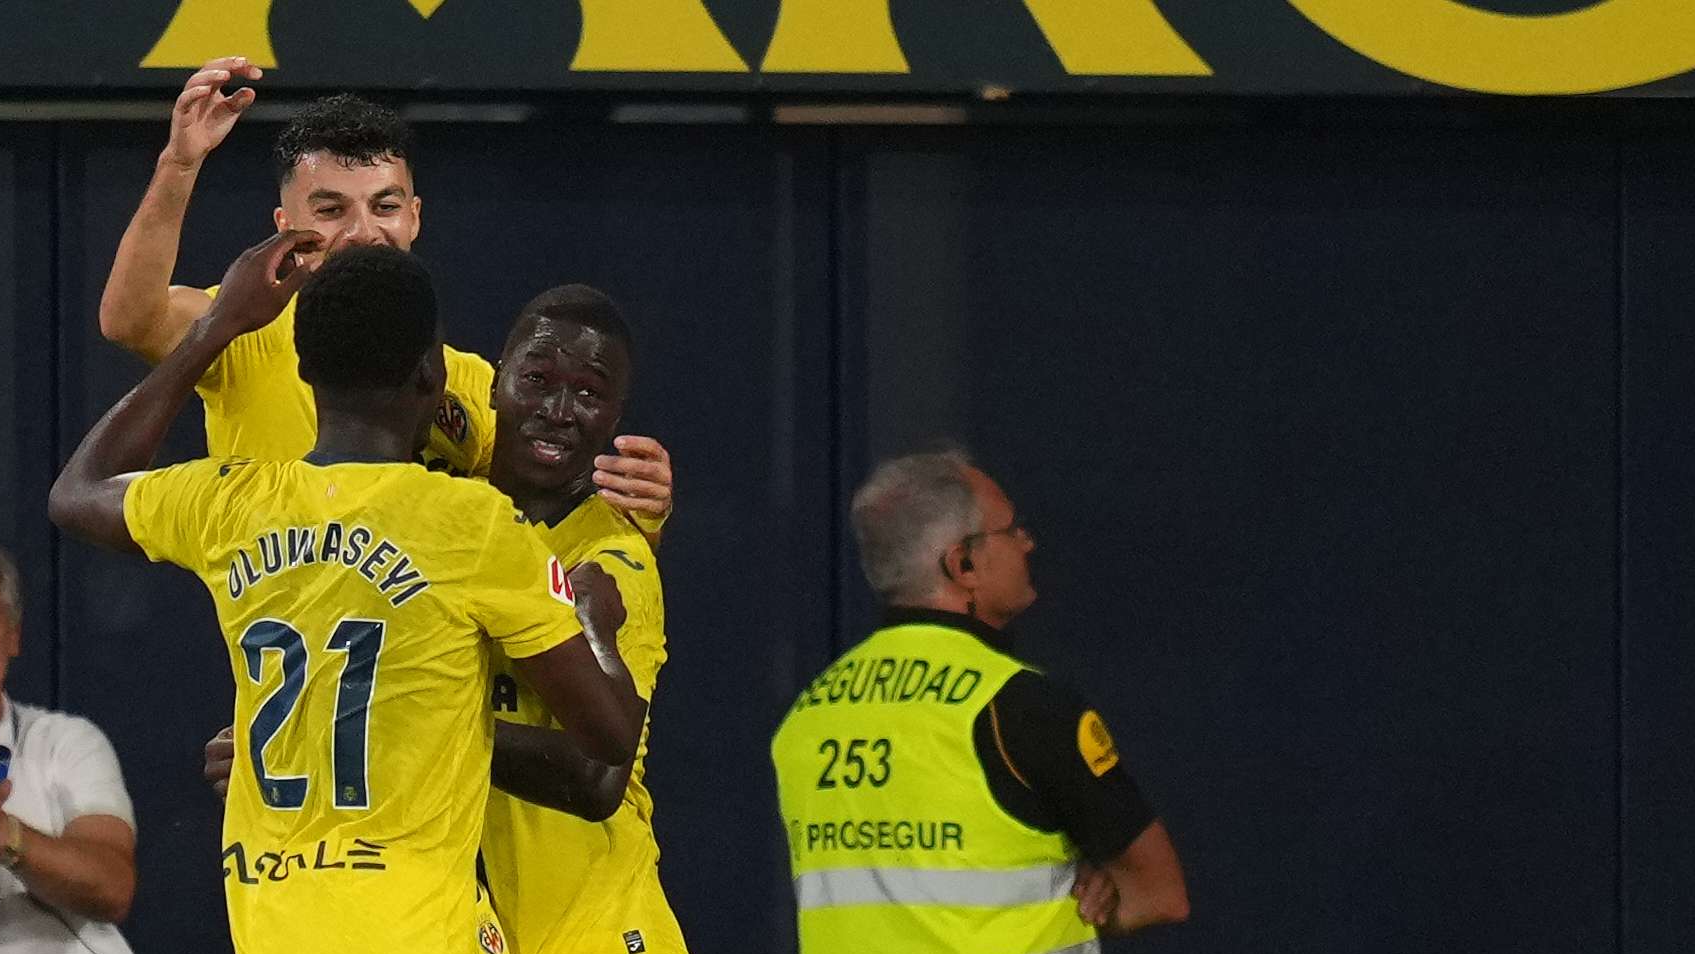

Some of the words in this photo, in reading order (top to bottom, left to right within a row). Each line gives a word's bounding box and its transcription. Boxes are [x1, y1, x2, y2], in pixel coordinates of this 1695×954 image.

[229, 522, 429, 608] OLUWASEYI
[238, 617, 386, 809] 21
[816, 738, 892, 790] 253
[807, 821, 964, 851] PROSEGUR
